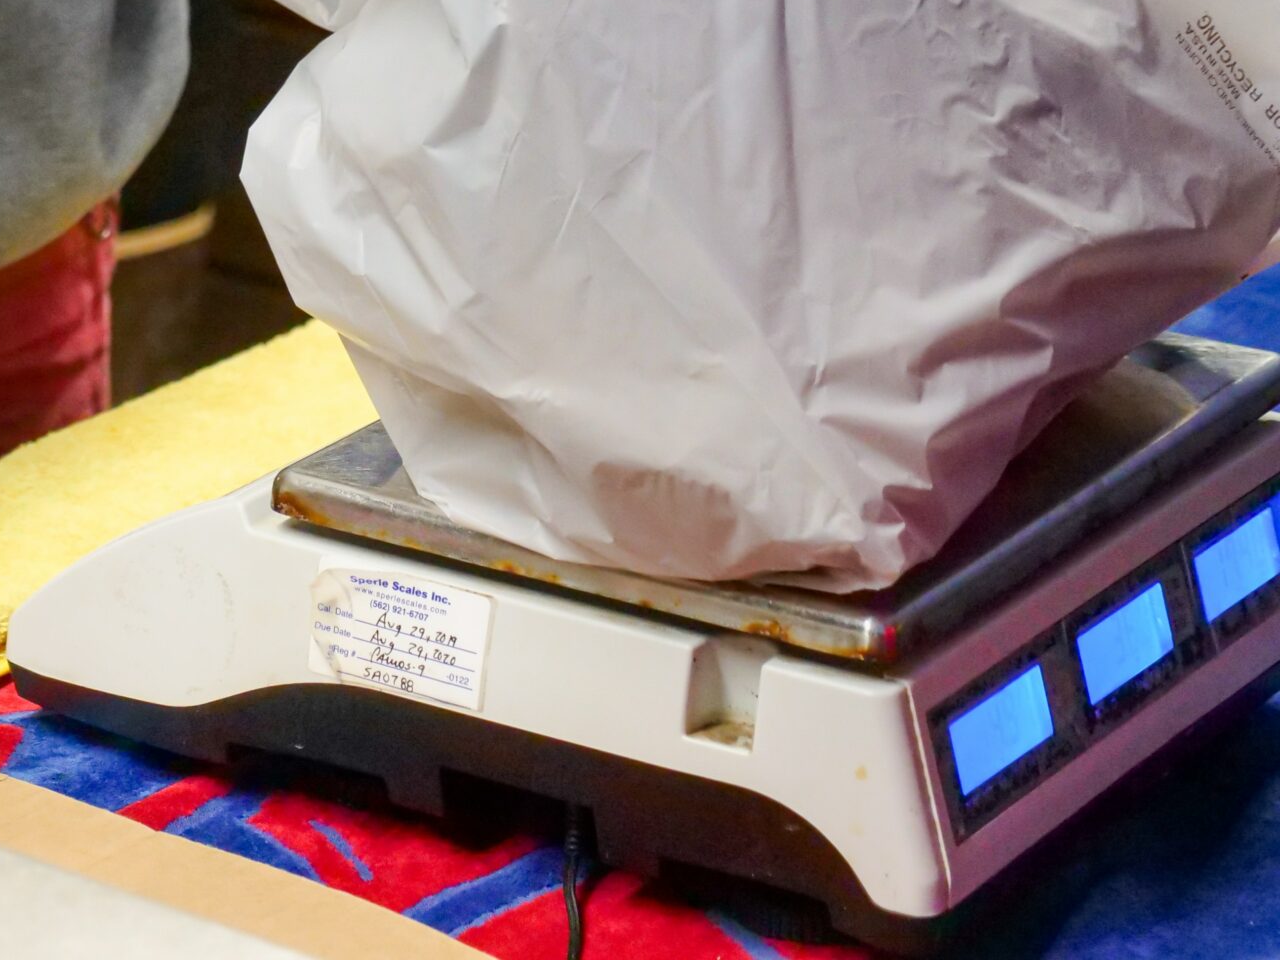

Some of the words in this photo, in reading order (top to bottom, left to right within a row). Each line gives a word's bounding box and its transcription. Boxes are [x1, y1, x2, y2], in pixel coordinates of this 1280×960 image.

[350, 575, 389, 588] Sperle
[392, 580, 428, 599] Scales
[431, 591, 452, 606] Inc.
[335, 607, 354, 619] Date
[370, 599, 390, 613] (562)
[392, 605, 429, 622] 921-6707
[314, 621, 332, 633] Due
[333, 626, 351, 639] Date
[376, 612, 402, 638] Aug
[370, 629, 395, 655] Aug
[432, 647, 457, 666] 2020
